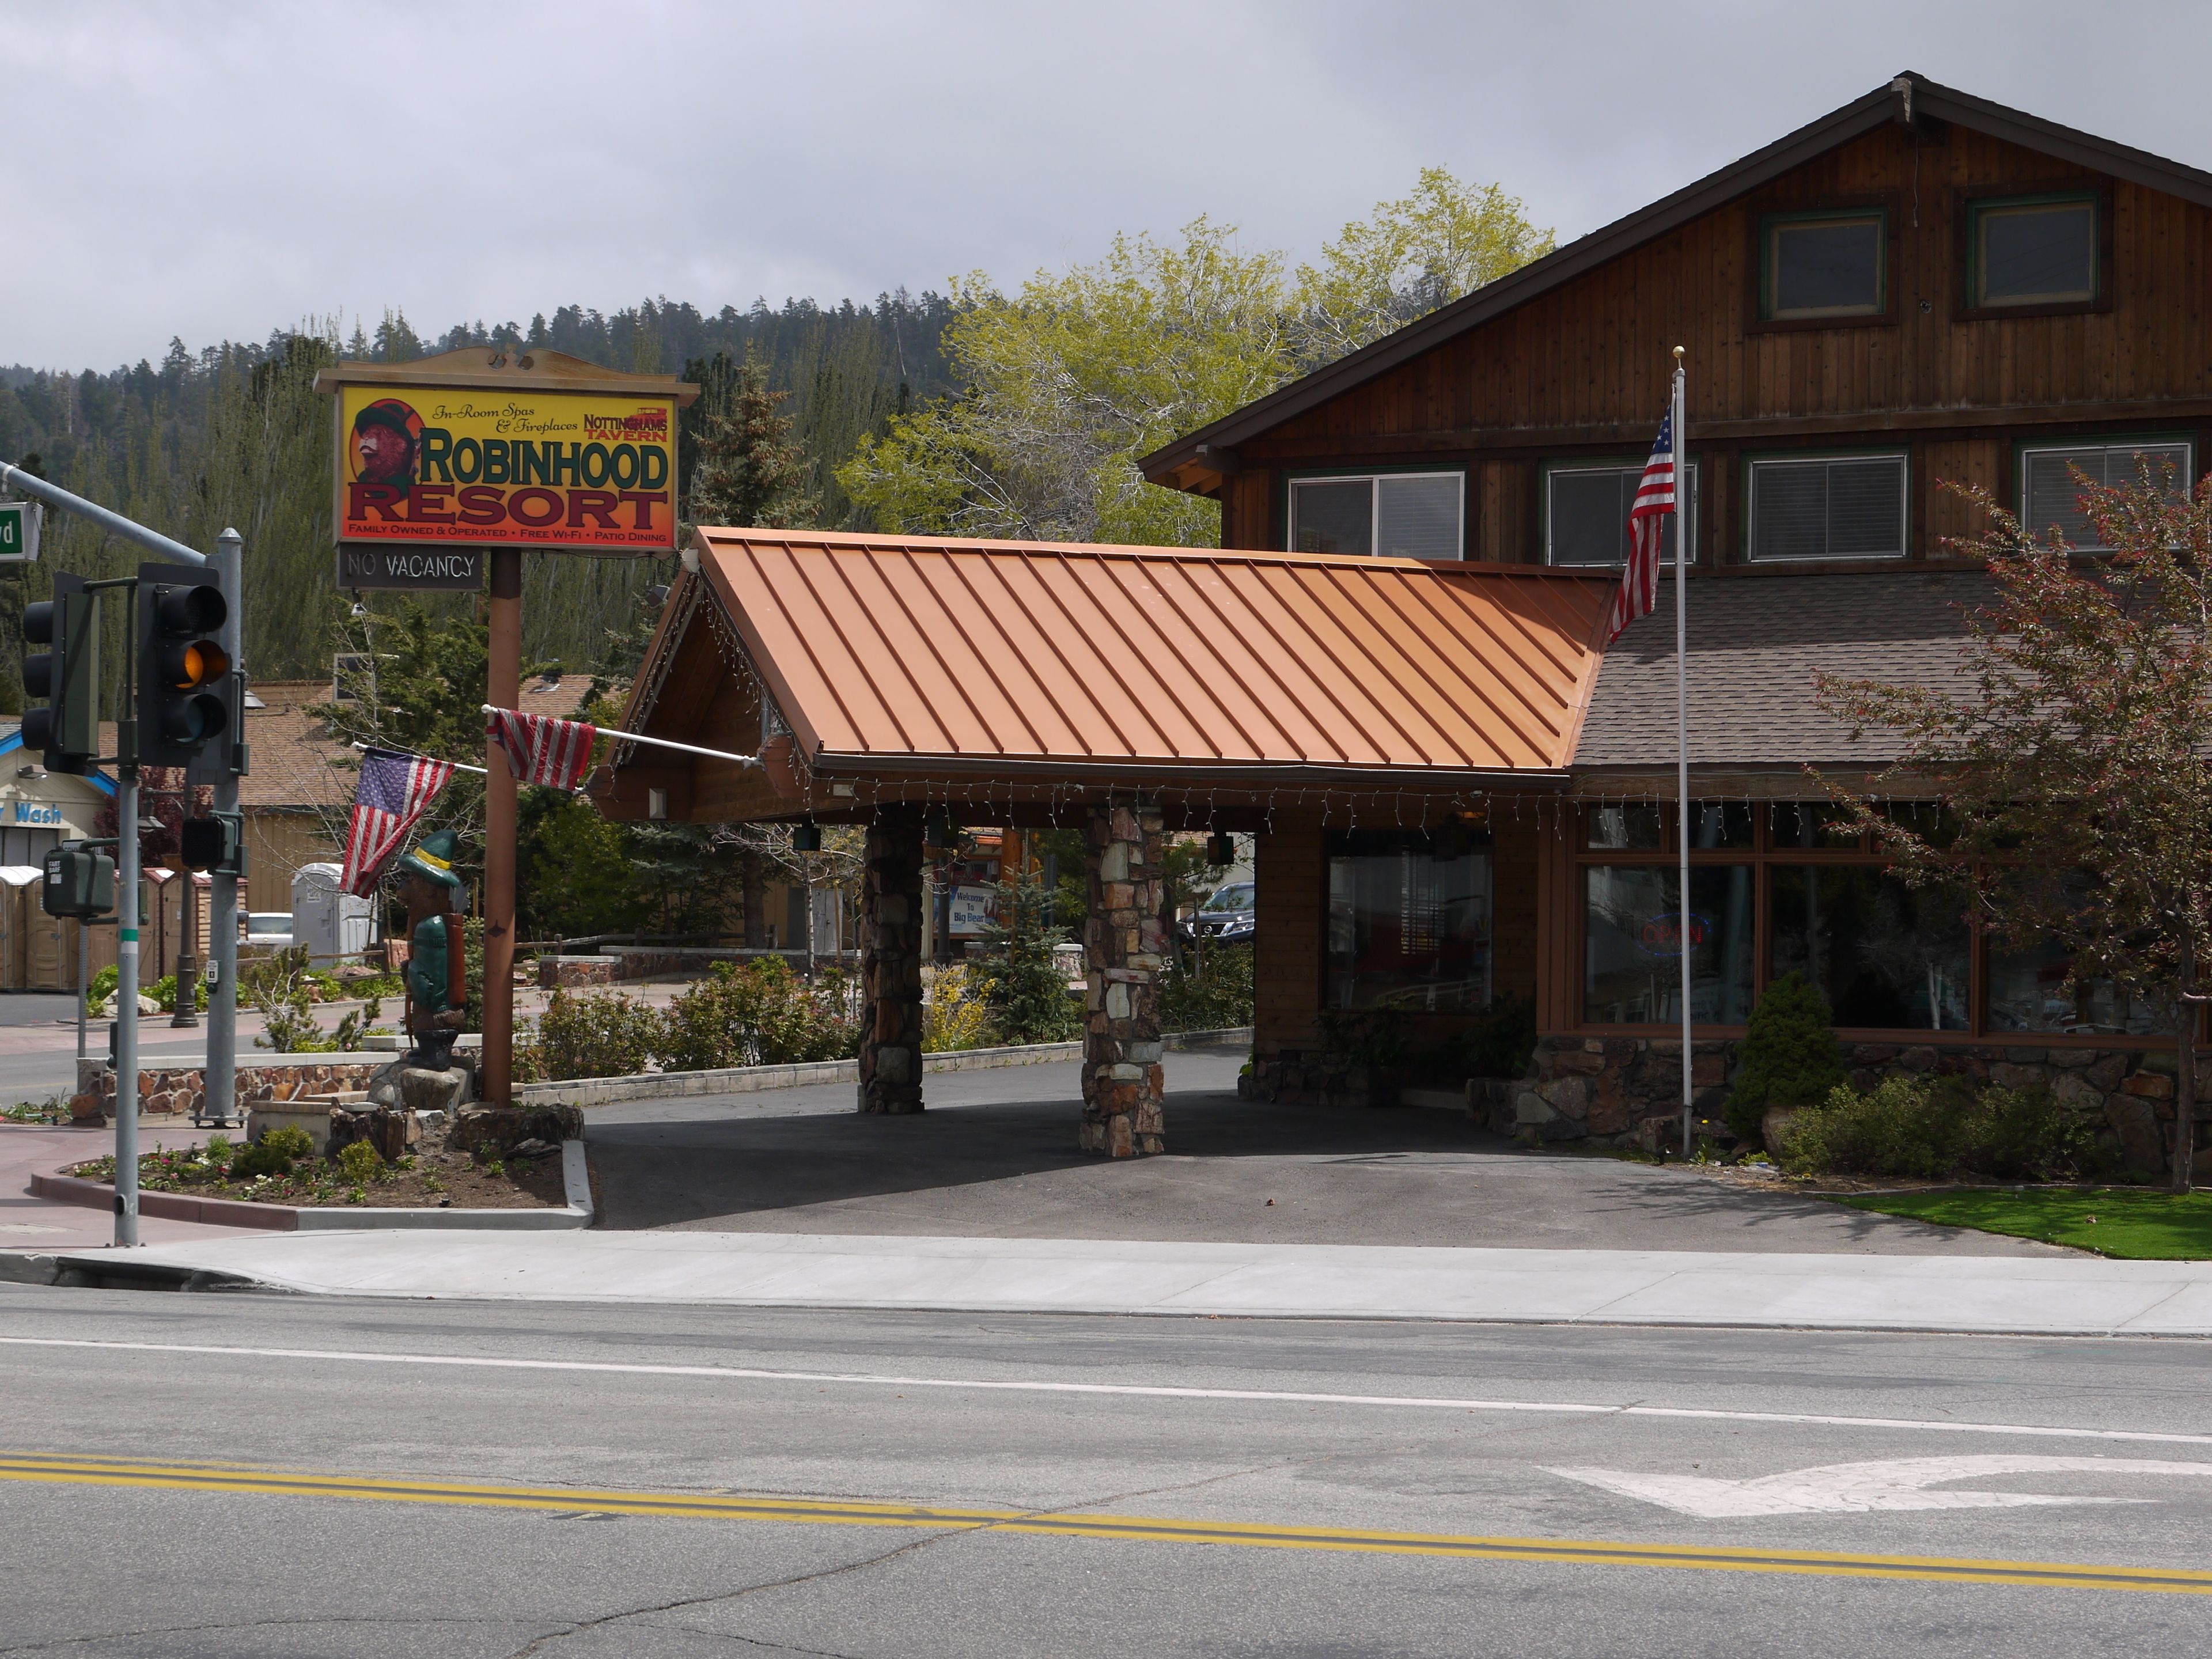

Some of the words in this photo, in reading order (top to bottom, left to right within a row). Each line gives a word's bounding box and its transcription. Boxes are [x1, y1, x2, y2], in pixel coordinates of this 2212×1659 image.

[432, 403, 499, 420] In-Room
[502, 403, 535, 421] Spas
[496, 419, 510, 433] &
[514, 418, 578, 435] Fireplaces
[584, 429, 668, 442] TAVERN
[419, 427, 668, 489] ROBINHOOD
[348, 482, 668, 529] RESORT
[349, 524, 387, 533] FAMILY
[391, 525, 434, 535] OWNED
[437, 527, 445, 535] &
[448, 527, 507, 537] OPERATED
[520, 529, 550, 538] FREE
[595, 532, 626, 540] PATIO
[628, 532, 666, 541] DINING
[348, 554, 376, 575] NO
[385, 555, 475, 578] VACANCY
[15, 802, 61, 824] Wash
[957, 892, 984, 903] Welcome
[967, 903, 974, 911] To
[954, 912, 966, 924] Big
[967, 912, 984, 923] Bear
[1643, 924, 1702, 944] OPEN
